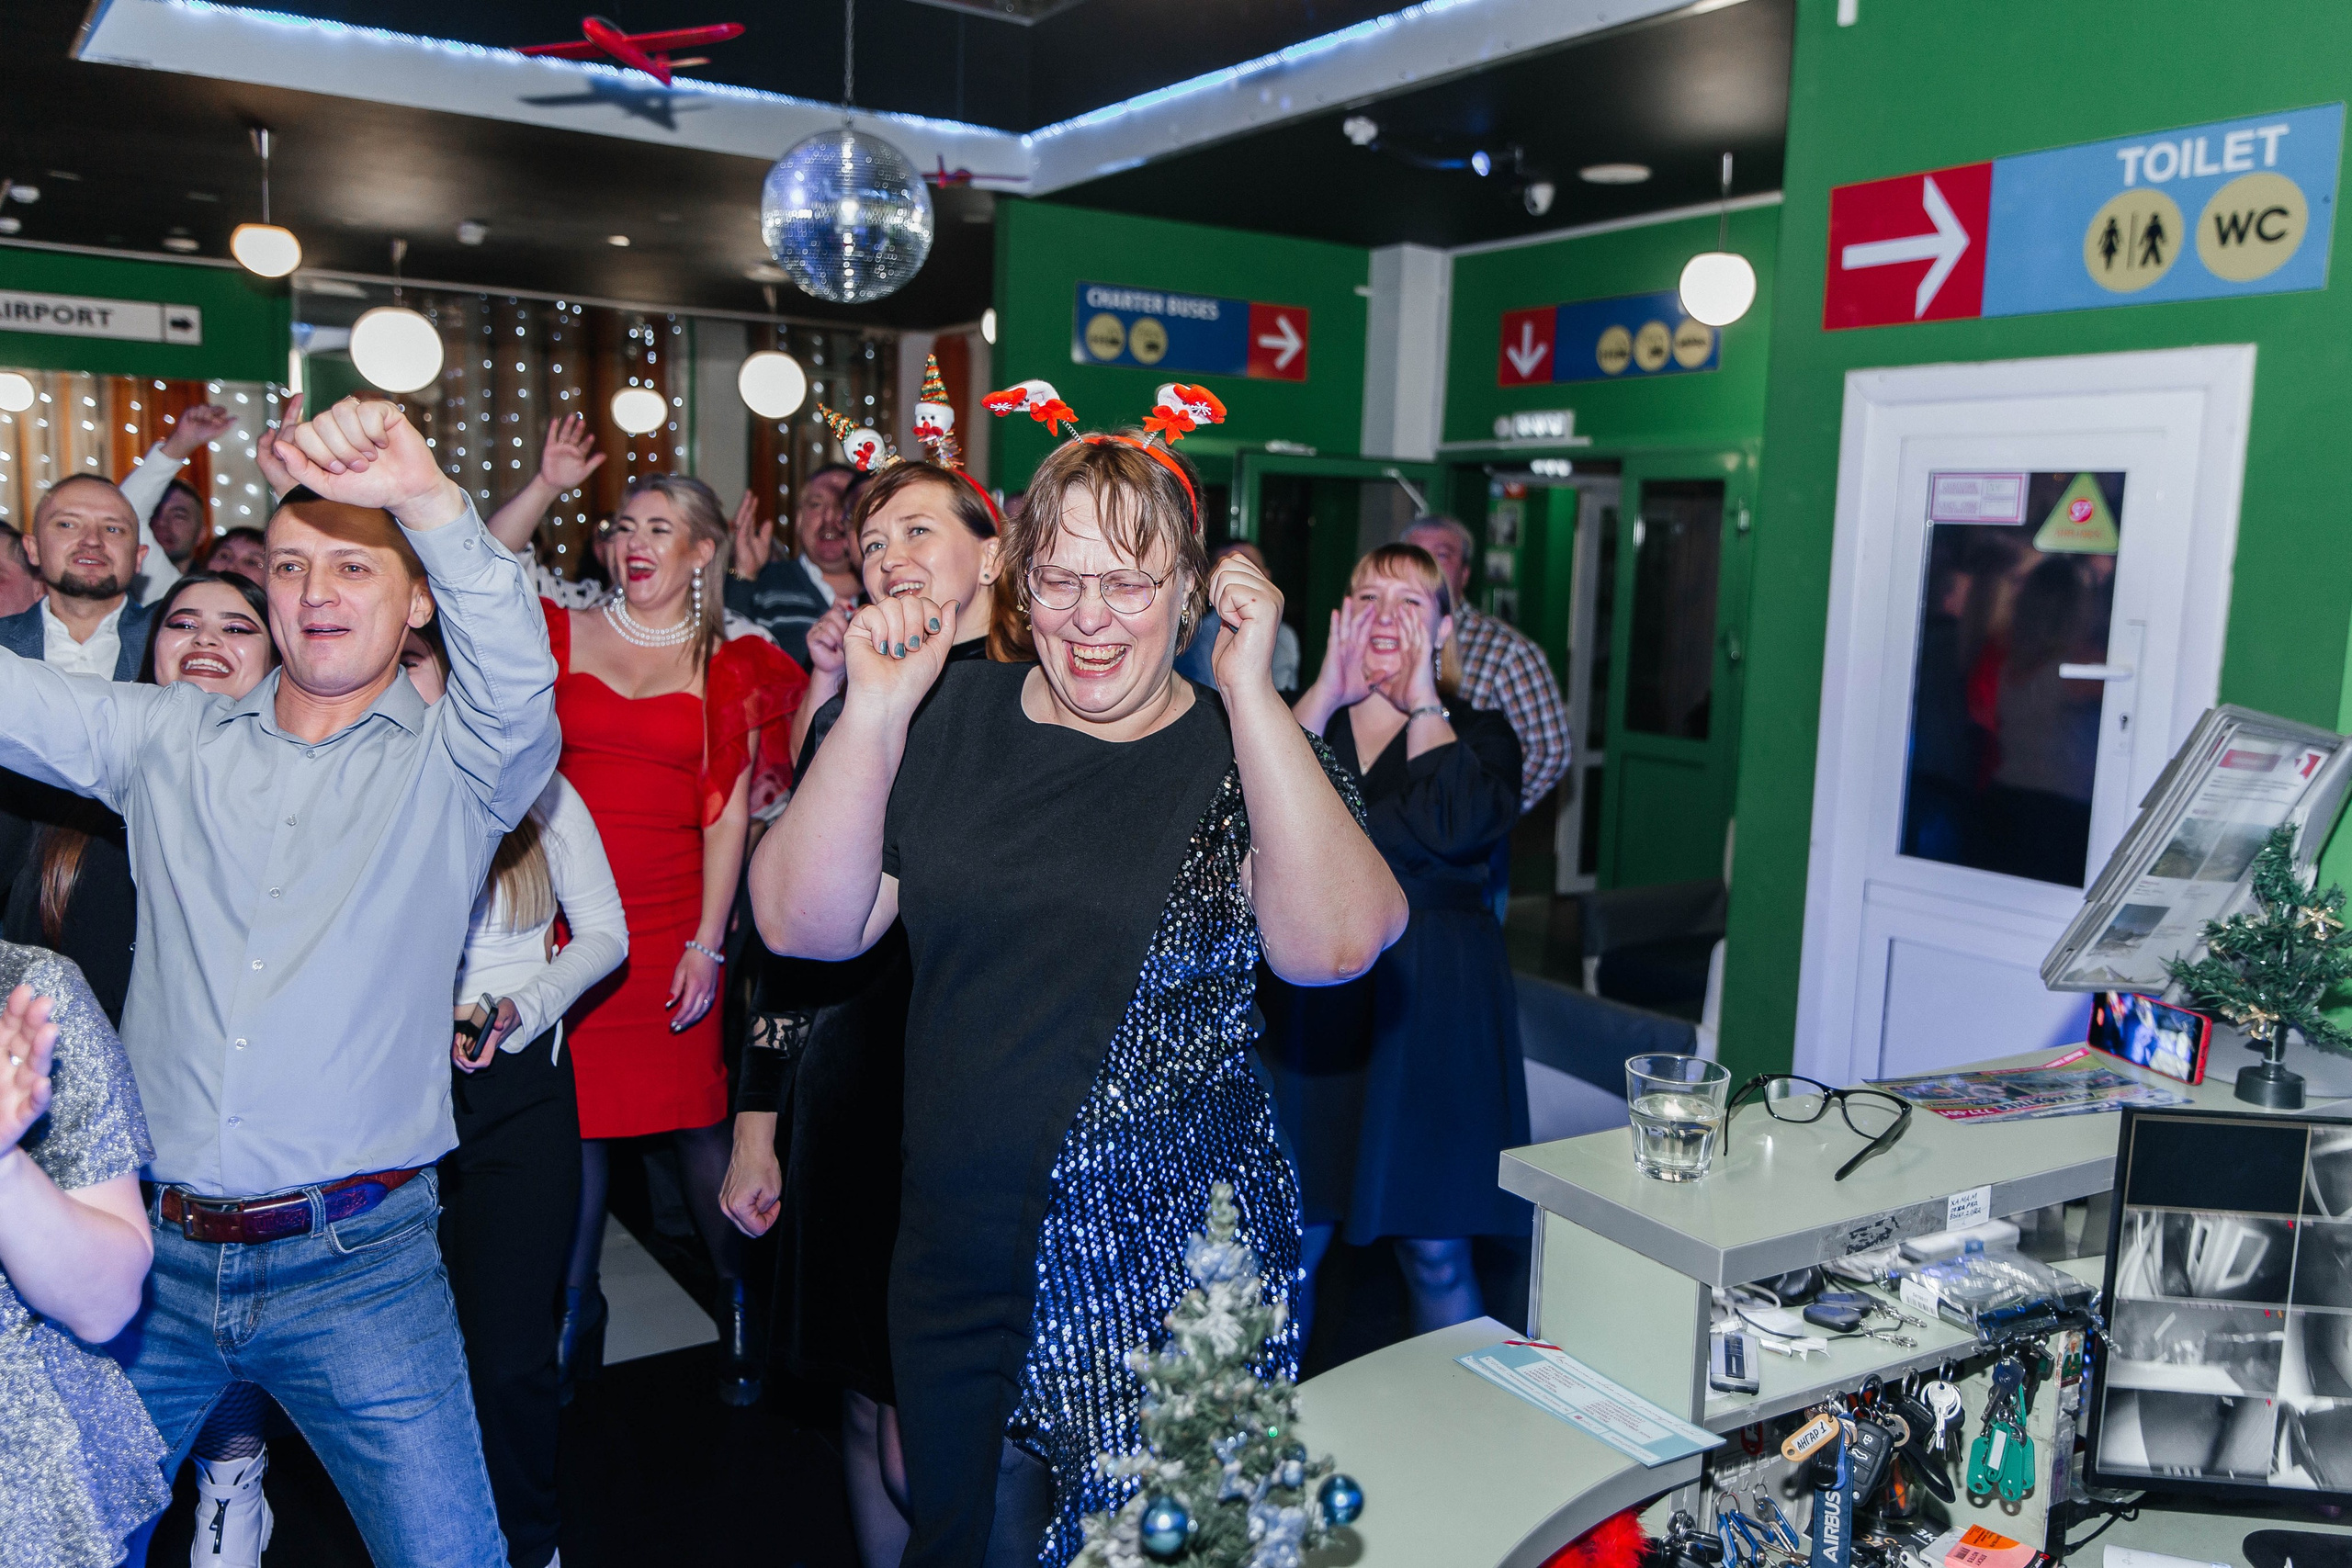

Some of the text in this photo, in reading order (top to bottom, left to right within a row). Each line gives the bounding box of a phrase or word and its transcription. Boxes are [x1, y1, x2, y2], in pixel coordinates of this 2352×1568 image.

[2116, 124, 2290, 187] TOILET
[2213, 206, 2290, 249] WC
[0, 299, 114, 326] IRPORT
[1086, 287, 1220, 321] CHARTER BUSES
[1796, 1421, 1826, 1451] АНГАР 1
[1822, 1490, 1841, 1563] AIRBUS
